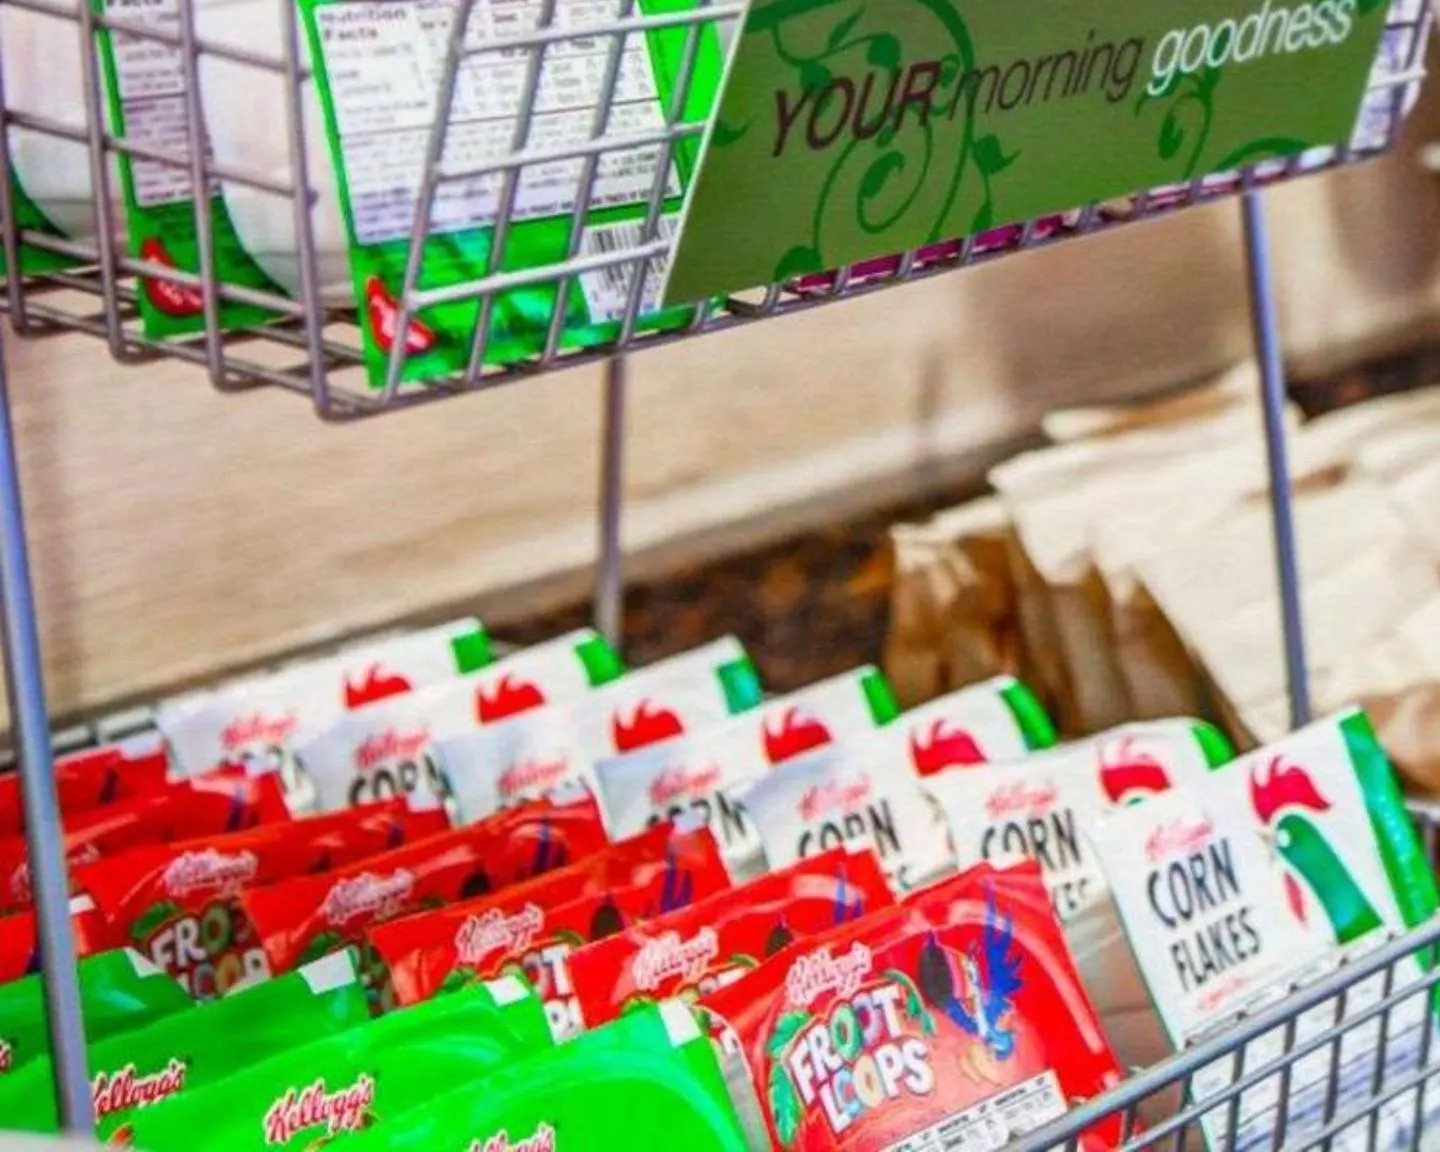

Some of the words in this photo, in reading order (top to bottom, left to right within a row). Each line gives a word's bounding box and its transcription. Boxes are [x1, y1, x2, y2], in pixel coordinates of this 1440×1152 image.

[772, 60, 942, 157] YOUR
[948, 34, 1144, 122] morning
[1147, 837, 1240, 929] CORN
[1170, 905, 1261, 992] FLAKES
[789, 984, 904, 1105] FROOT
[818, 1038, 934, 1134] LOOPS
[264, 1074, 375, 1145] Kellogg's
